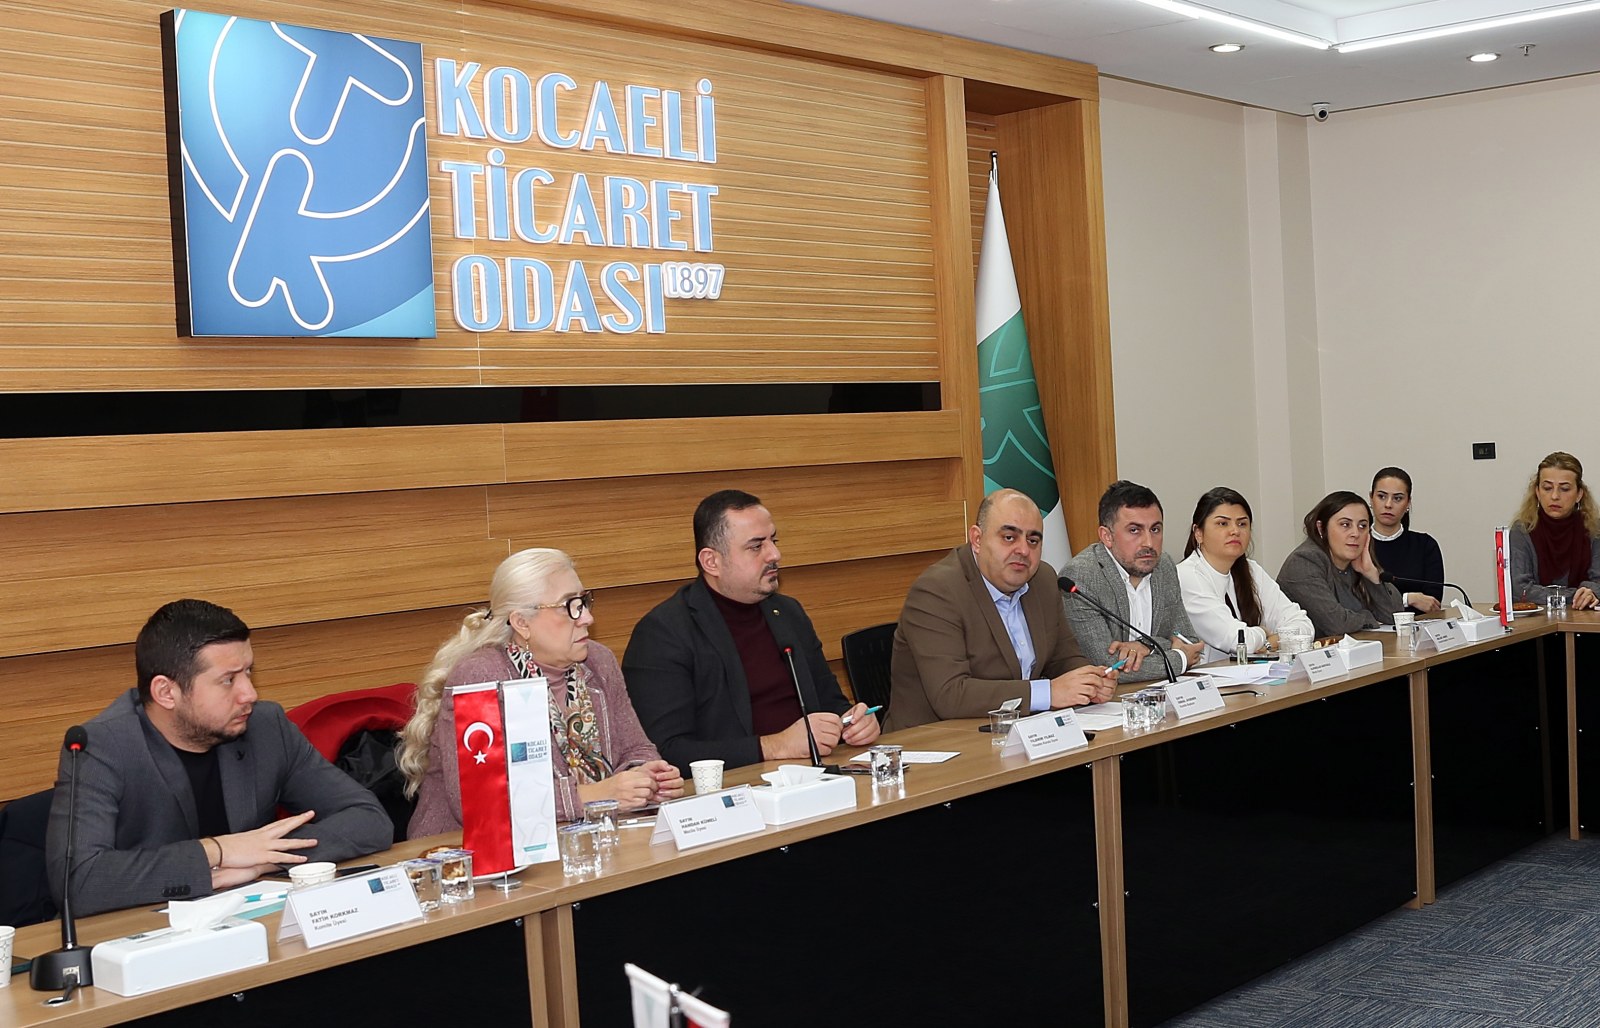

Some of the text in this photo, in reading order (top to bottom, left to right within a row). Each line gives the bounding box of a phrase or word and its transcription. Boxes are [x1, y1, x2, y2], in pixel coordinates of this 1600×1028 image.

[435, 57, 716, 163] KOCAELİ
[440, 148, 718, 252] TİCARET
[452, 254, 722, 333] ODASI 1897
[309, 909, 328, 918] SAYIN
[330, 907, 359, 920] KORKMAZ
